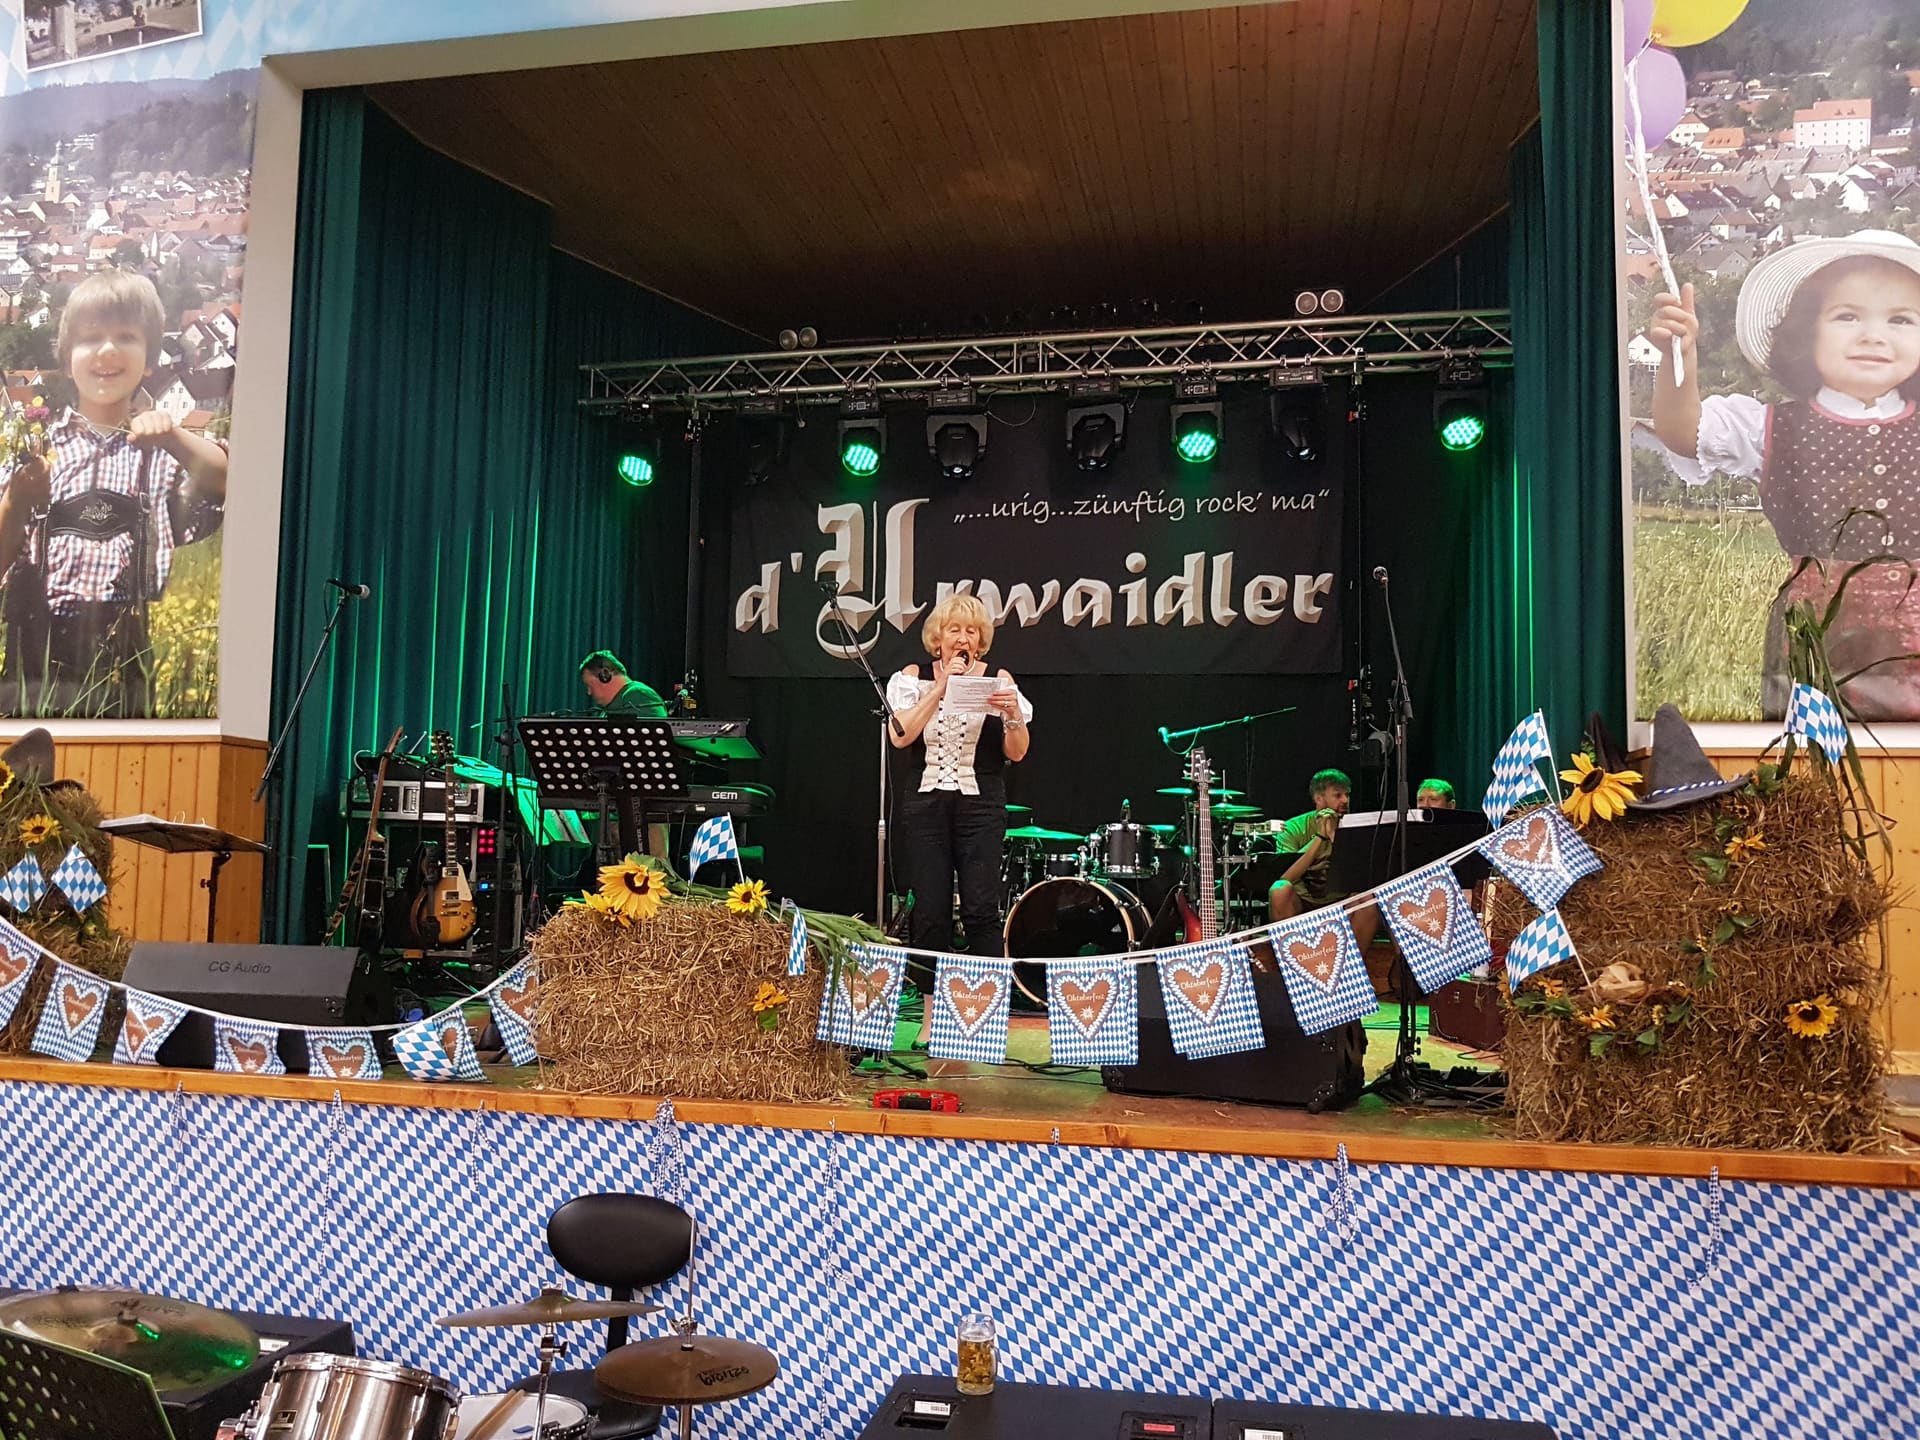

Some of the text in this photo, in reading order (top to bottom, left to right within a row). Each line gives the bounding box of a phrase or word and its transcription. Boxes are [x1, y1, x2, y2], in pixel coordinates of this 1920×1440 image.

[209, 960, 272, 974] CG Audio
[1180, 976, 1219, 990] Oktoberfest
[952, 990, 991, 1002] Oktoberfest
[1066, 992, 1105, 1003] Oktoberfest
